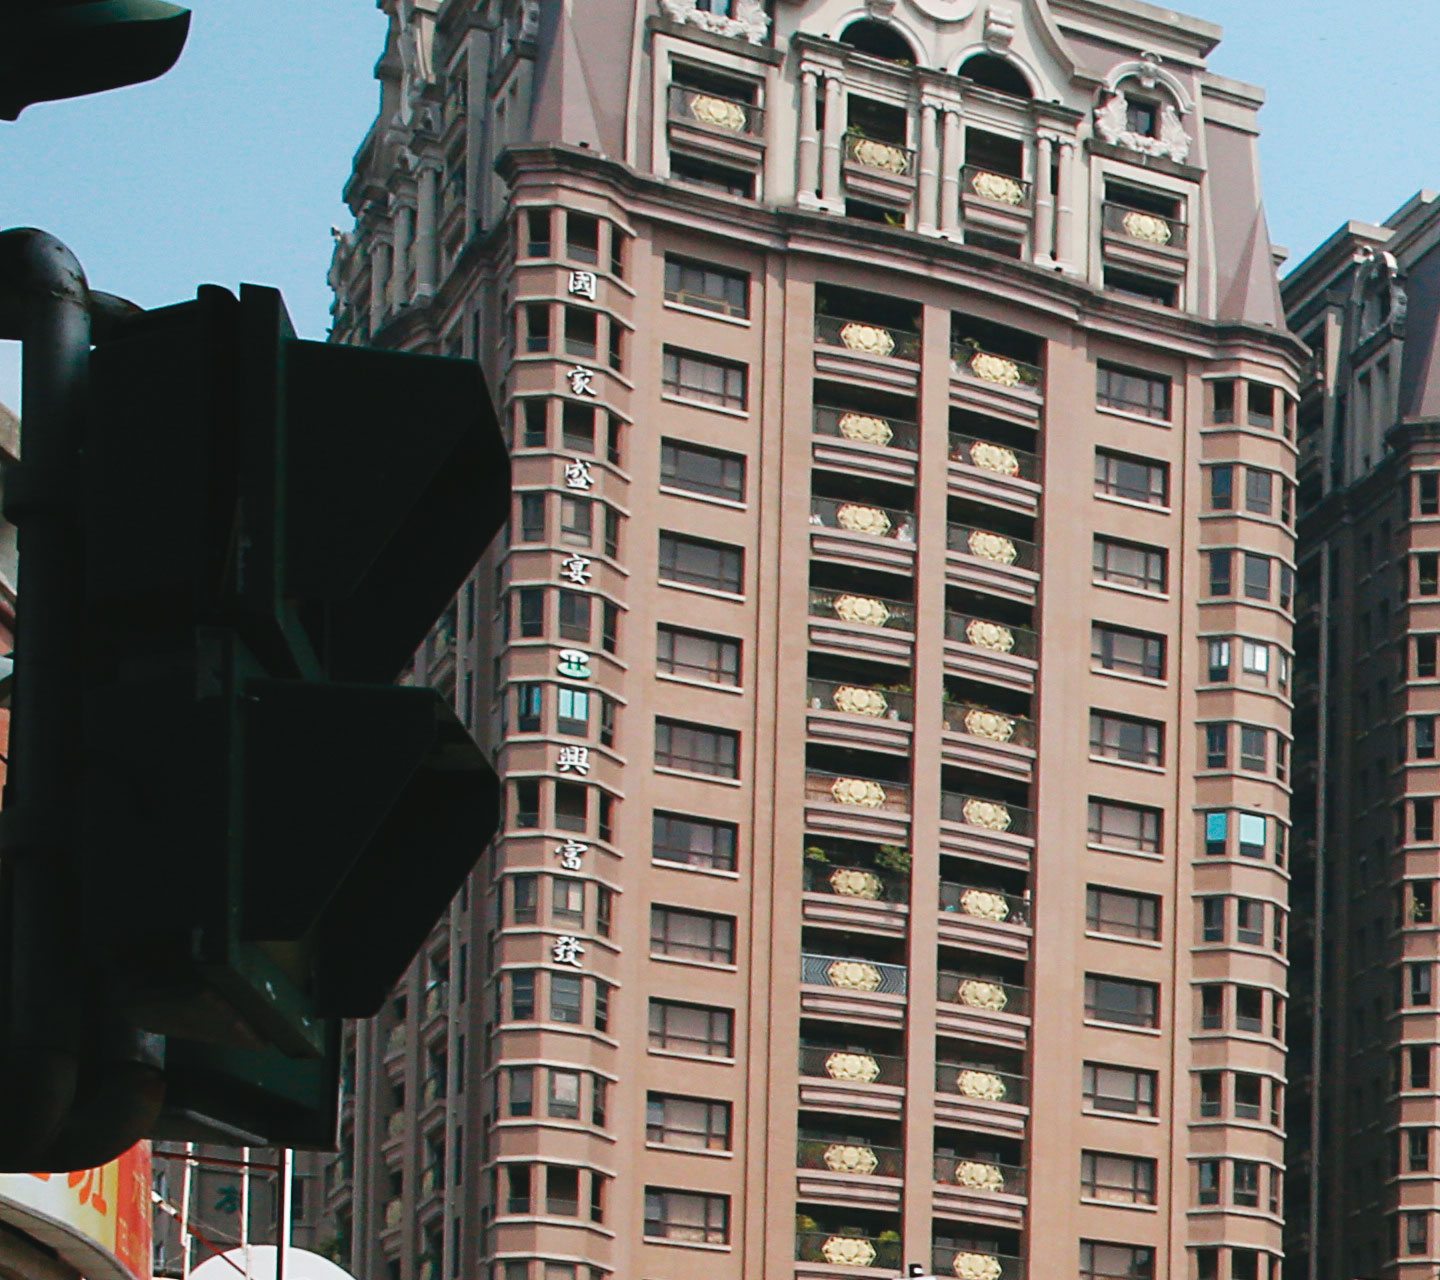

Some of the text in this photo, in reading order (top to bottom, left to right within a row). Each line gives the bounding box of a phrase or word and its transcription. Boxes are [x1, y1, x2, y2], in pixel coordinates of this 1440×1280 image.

[560, 270, 598, 586] 國家盛宴
[552, 746, 591, 968] 興富發
